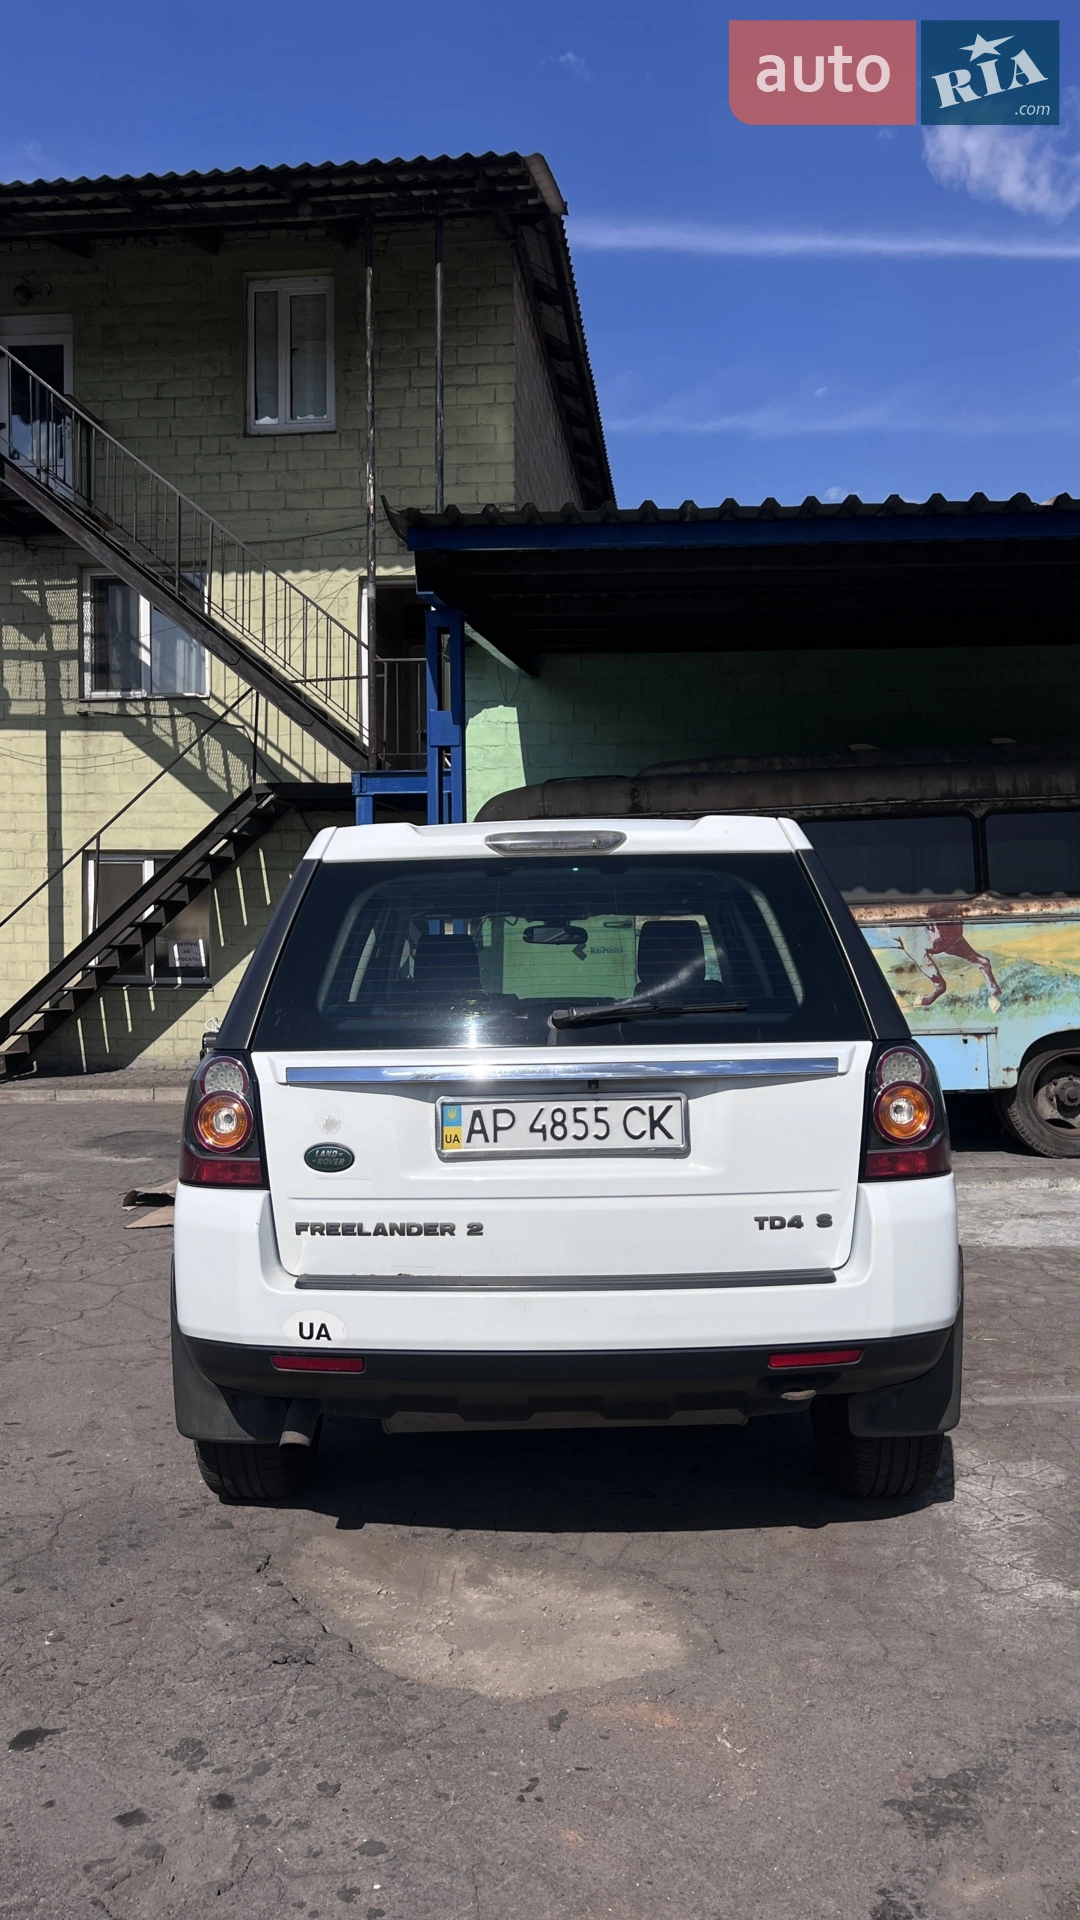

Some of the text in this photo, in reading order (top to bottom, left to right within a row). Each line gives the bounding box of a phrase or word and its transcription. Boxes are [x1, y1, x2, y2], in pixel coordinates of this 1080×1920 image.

[466, 1104, 675, 1144] AP 4855 CK
[445, 1134, 461, 1144] UA
[315, 1150, 338, 1158] LAND
[316, 1157, 346, 1166] ROVER
[295, 1221, 484, 1236] FREELANDER 2
[753, 1213, 833, 1231] TD4 S
[298, 1321, 333, 1341] UA
